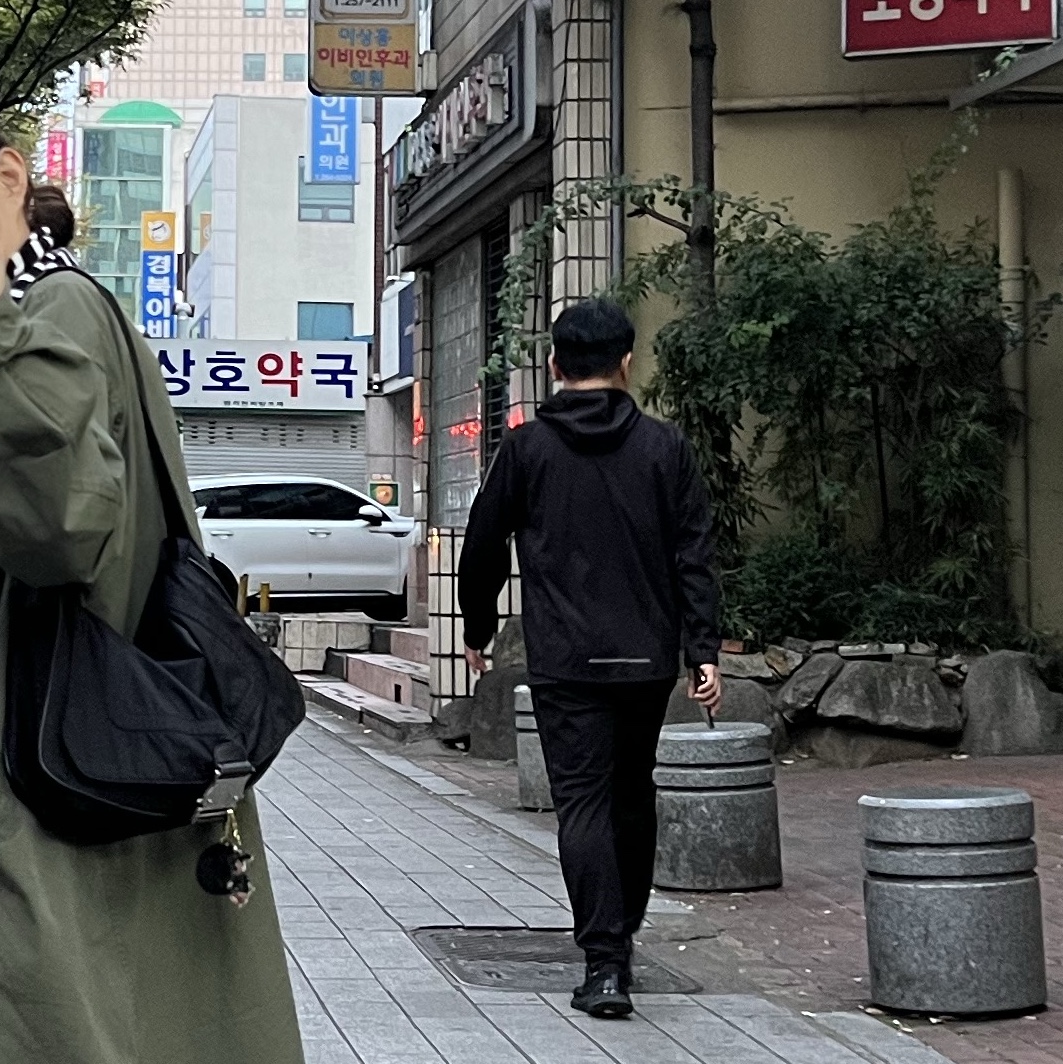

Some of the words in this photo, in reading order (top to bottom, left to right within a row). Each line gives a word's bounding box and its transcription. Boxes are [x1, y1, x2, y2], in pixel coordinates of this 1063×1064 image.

[317, 48, 411, 68] 이비인후과
[319, 154, 350, 171] 의원
[146, 255, 171, 338] 경북이비
[157, 348, 358, 399] 상호약국
